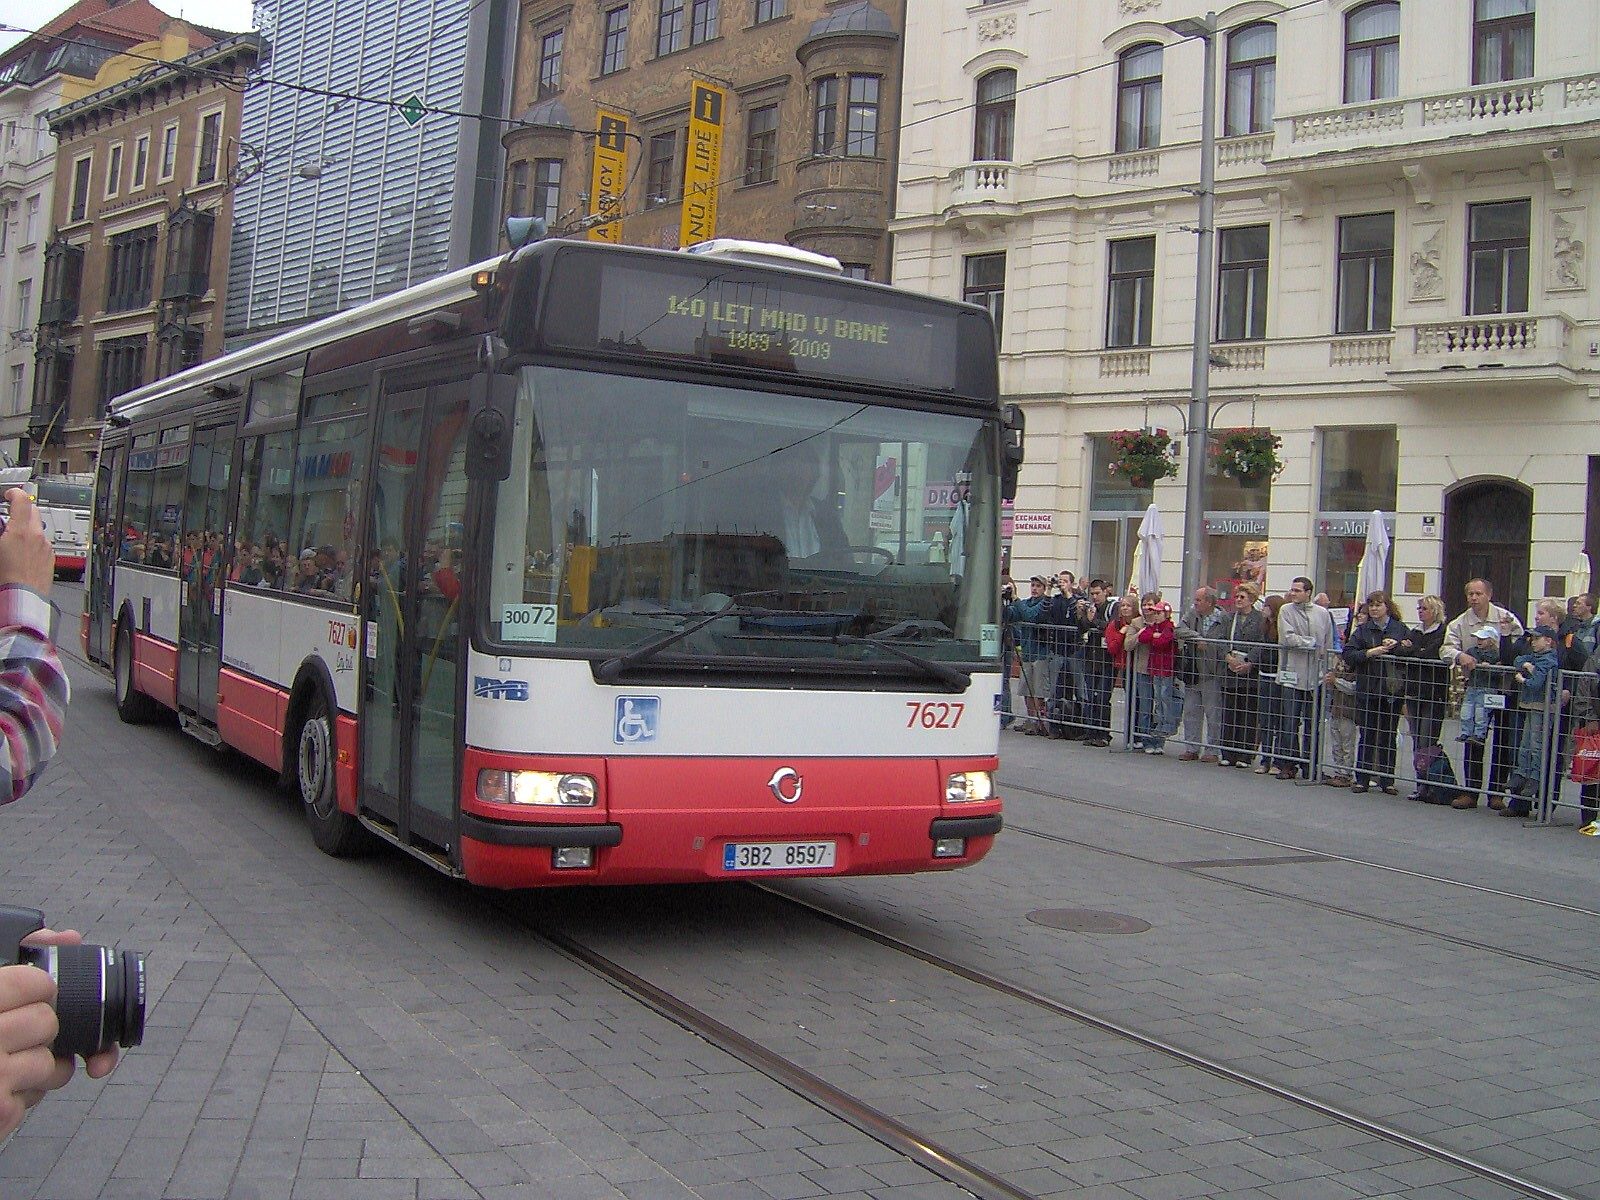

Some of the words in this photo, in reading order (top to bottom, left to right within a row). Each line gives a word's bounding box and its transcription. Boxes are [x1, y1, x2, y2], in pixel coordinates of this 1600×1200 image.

[597, 165, 613, 239] AENCY
[693, 181, 707, 196] Z
[686, 203, 707, 244] NŮ
[667, 295, 705, 318] 140
[712, 301, 754, 324] LET
[760, 307, 807, 332] MHD
[727, 328, 770, 351] 1869
[788, 337, 831, 360] 2009
[1343, 520, 1370, 535] Mob
[328, 620, 346, 646] 7627
[905, 701, 966, 729] 7627
[739, 846, 773, 867] 3B2
[785, 844, 827, 865] 8597
